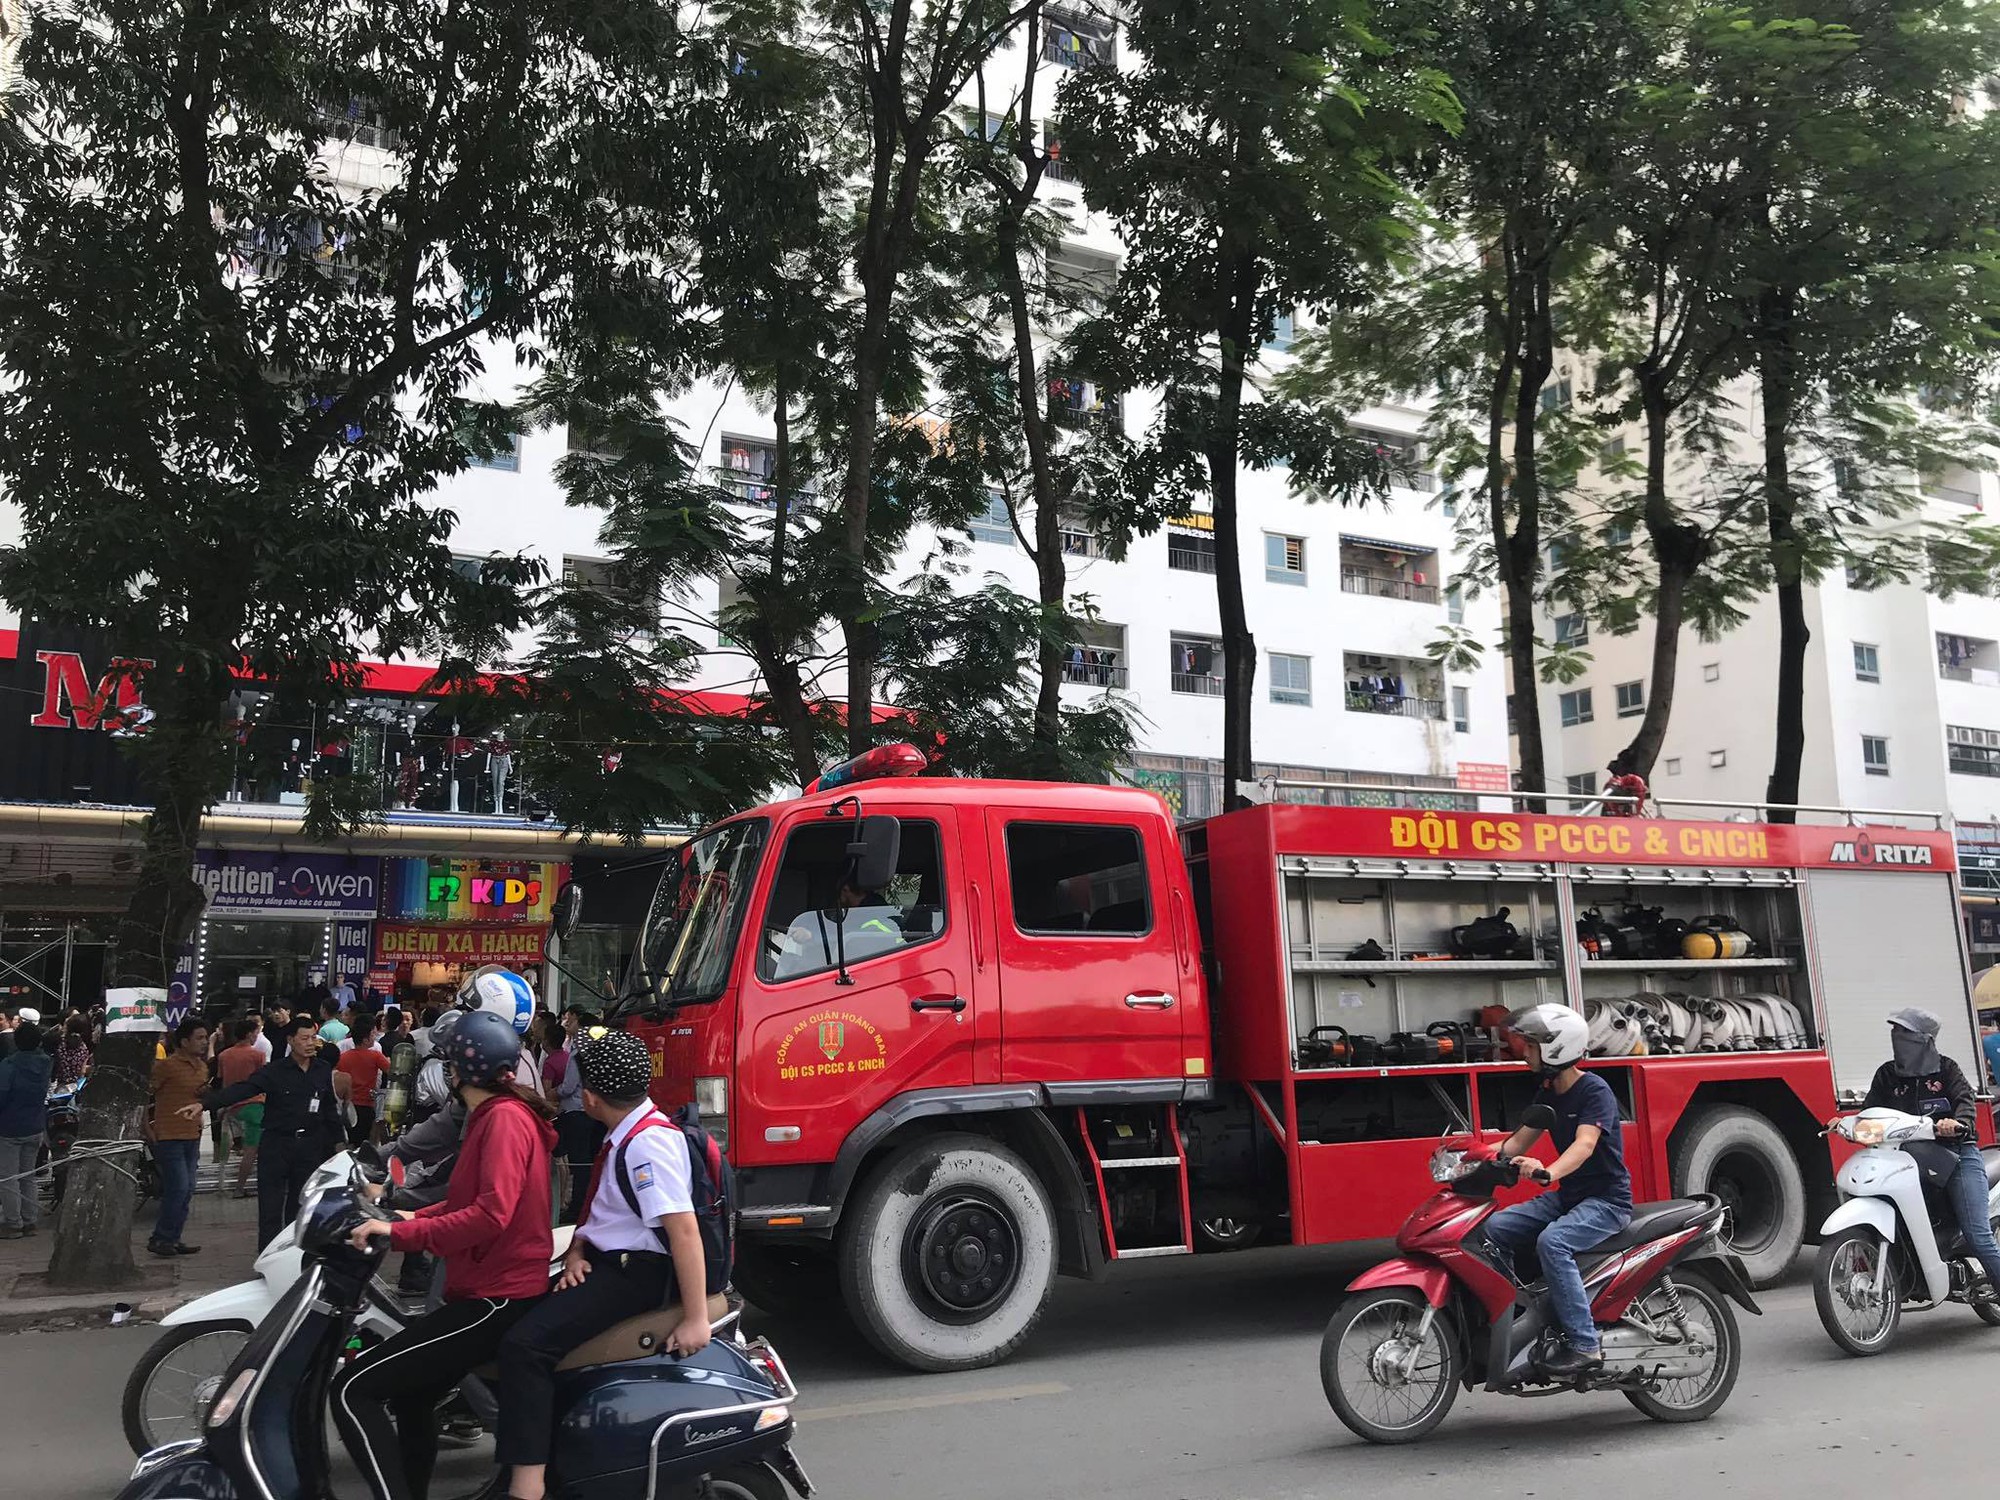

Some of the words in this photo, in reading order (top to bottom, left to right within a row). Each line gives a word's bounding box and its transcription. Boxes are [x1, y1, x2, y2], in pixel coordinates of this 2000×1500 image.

[1390, 811, 1459, 855] ĐỘI
[1471, 820, 1522, 852] CS
[1533, 822, 1631, 854] PCCC
[1644, 826, 1669, 855] &
[1679, 827, 1768, 859] CNCH
[1830, 833, 1932, 865] MORITA
[291, 867, 373, 897] Owen
[428, 875, 461, 902] F2
[470, 877, 542, 906] KIDS
[284, 898, 297, 906] cho
[323, 900, 341, 908] quan
[339, 926, 367, 947] Viet
[481, 930, 539, 953] HÀNG
[336, 953, 365, 974] tien
[777, 1034, 794, 1065] CÔNG
[793, 1021, 808, 1035] AN
[873, 1033, 887, 1056] MAI
[781, 1065, 798, 1080] ĐỘI
[801, 1065, 815, 1078] CS
[817, 1062, 844, 1075] PCCC
[847, 1061, 856, 1072] &
[858, 1058, 885, 1071] CNCH
[684, 1424, 742, 1447] Vespa
